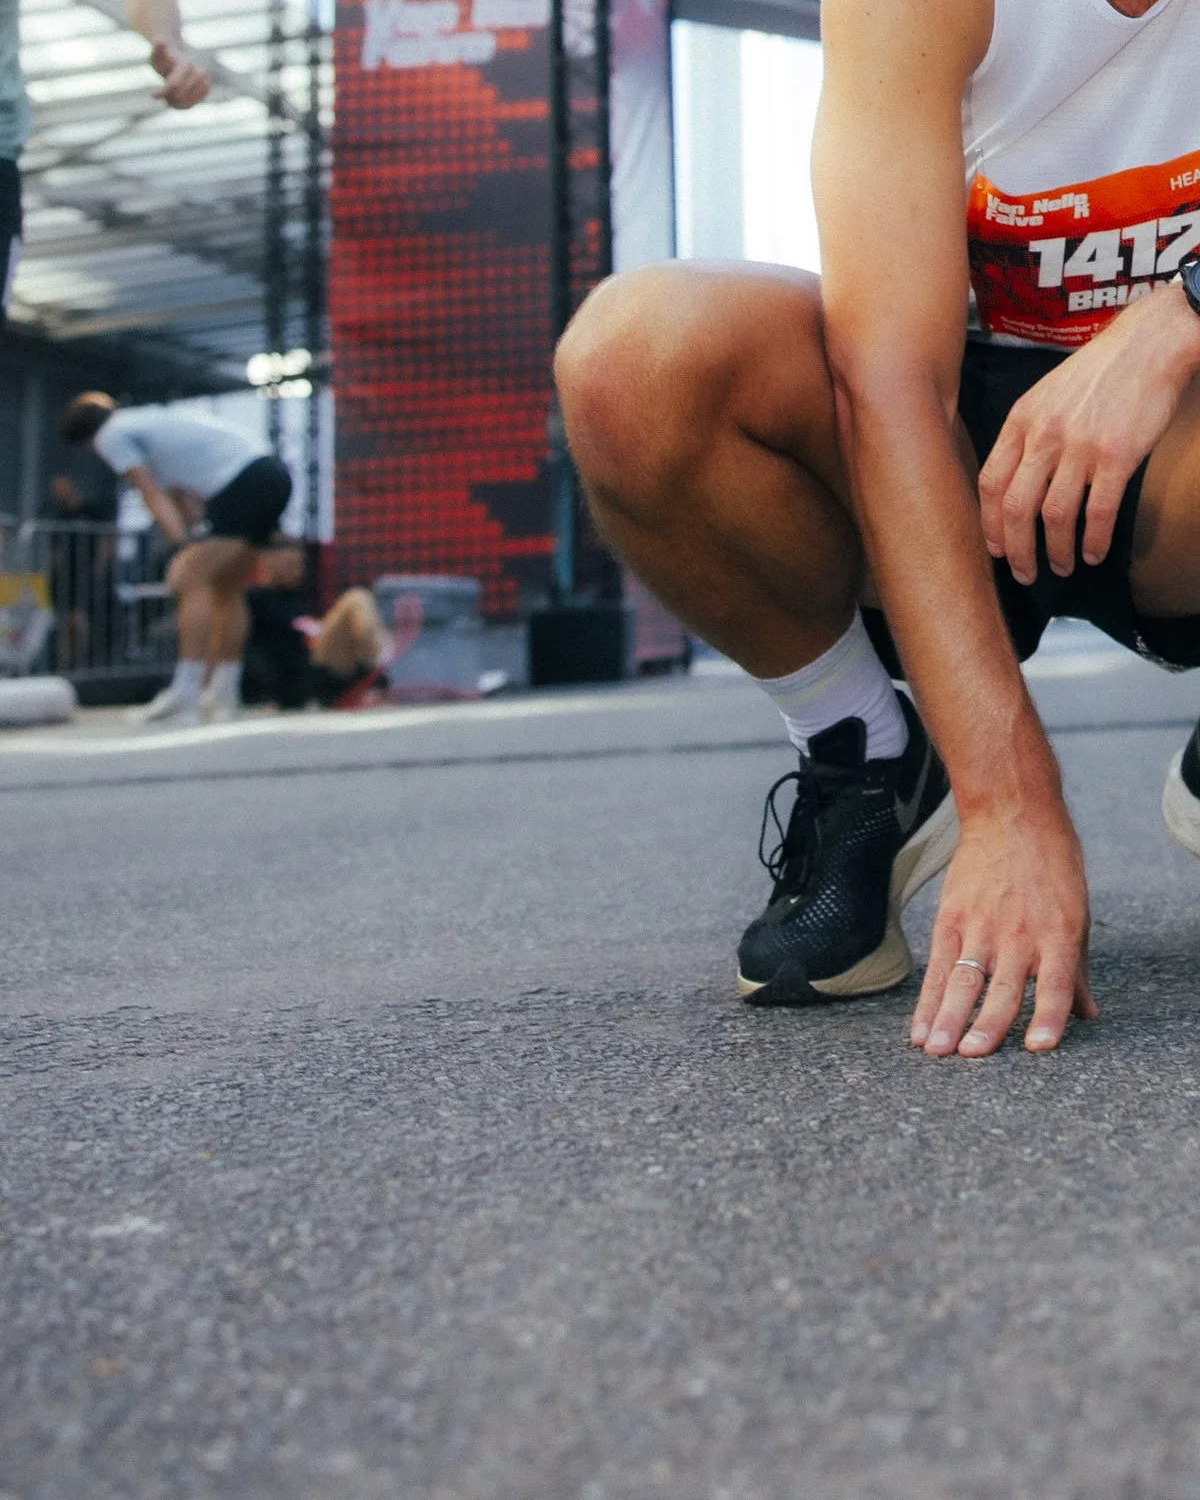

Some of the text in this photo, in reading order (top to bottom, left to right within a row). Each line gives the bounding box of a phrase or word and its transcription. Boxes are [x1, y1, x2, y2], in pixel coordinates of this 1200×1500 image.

[987, 192, 1088, 215] Van Nelle
[1036, 323, 1092, 334] September
